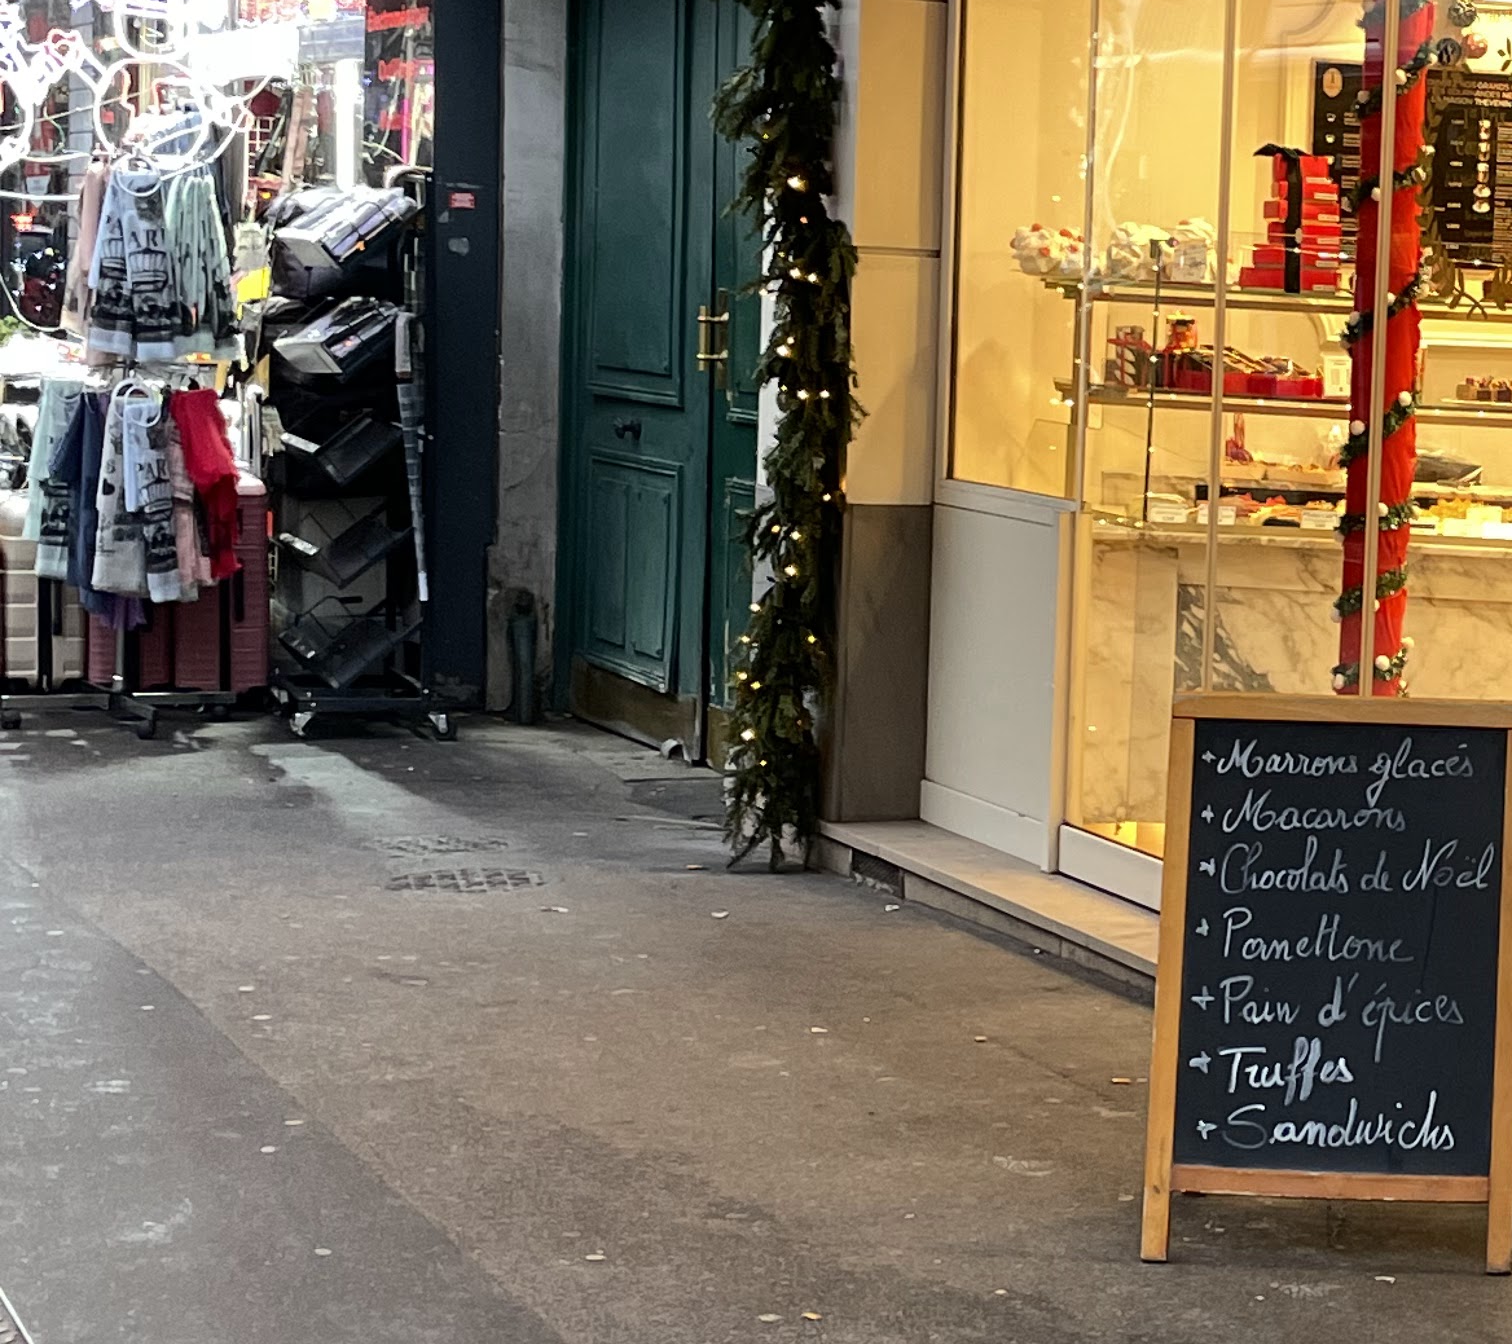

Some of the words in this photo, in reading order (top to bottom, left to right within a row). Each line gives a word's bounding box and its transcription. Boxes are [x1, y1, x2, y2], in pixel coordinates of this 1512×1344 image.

[1217, 738, 1358, 778] Marrons
[1367, 736, 1474, 807] glacés
[1223, 787, 1406, 833] Macarons
[1220, 835, 1349, 895] Chocolats
[1360, 848, 1394, 892] de
[1403, 838, 1495, 892] Noël
[1220, 974, 1300, 1026] Pain
[1217, 1036, 1354, 1105] Truffes
[1222, 1091, 1455, 1150] Sandwichs
